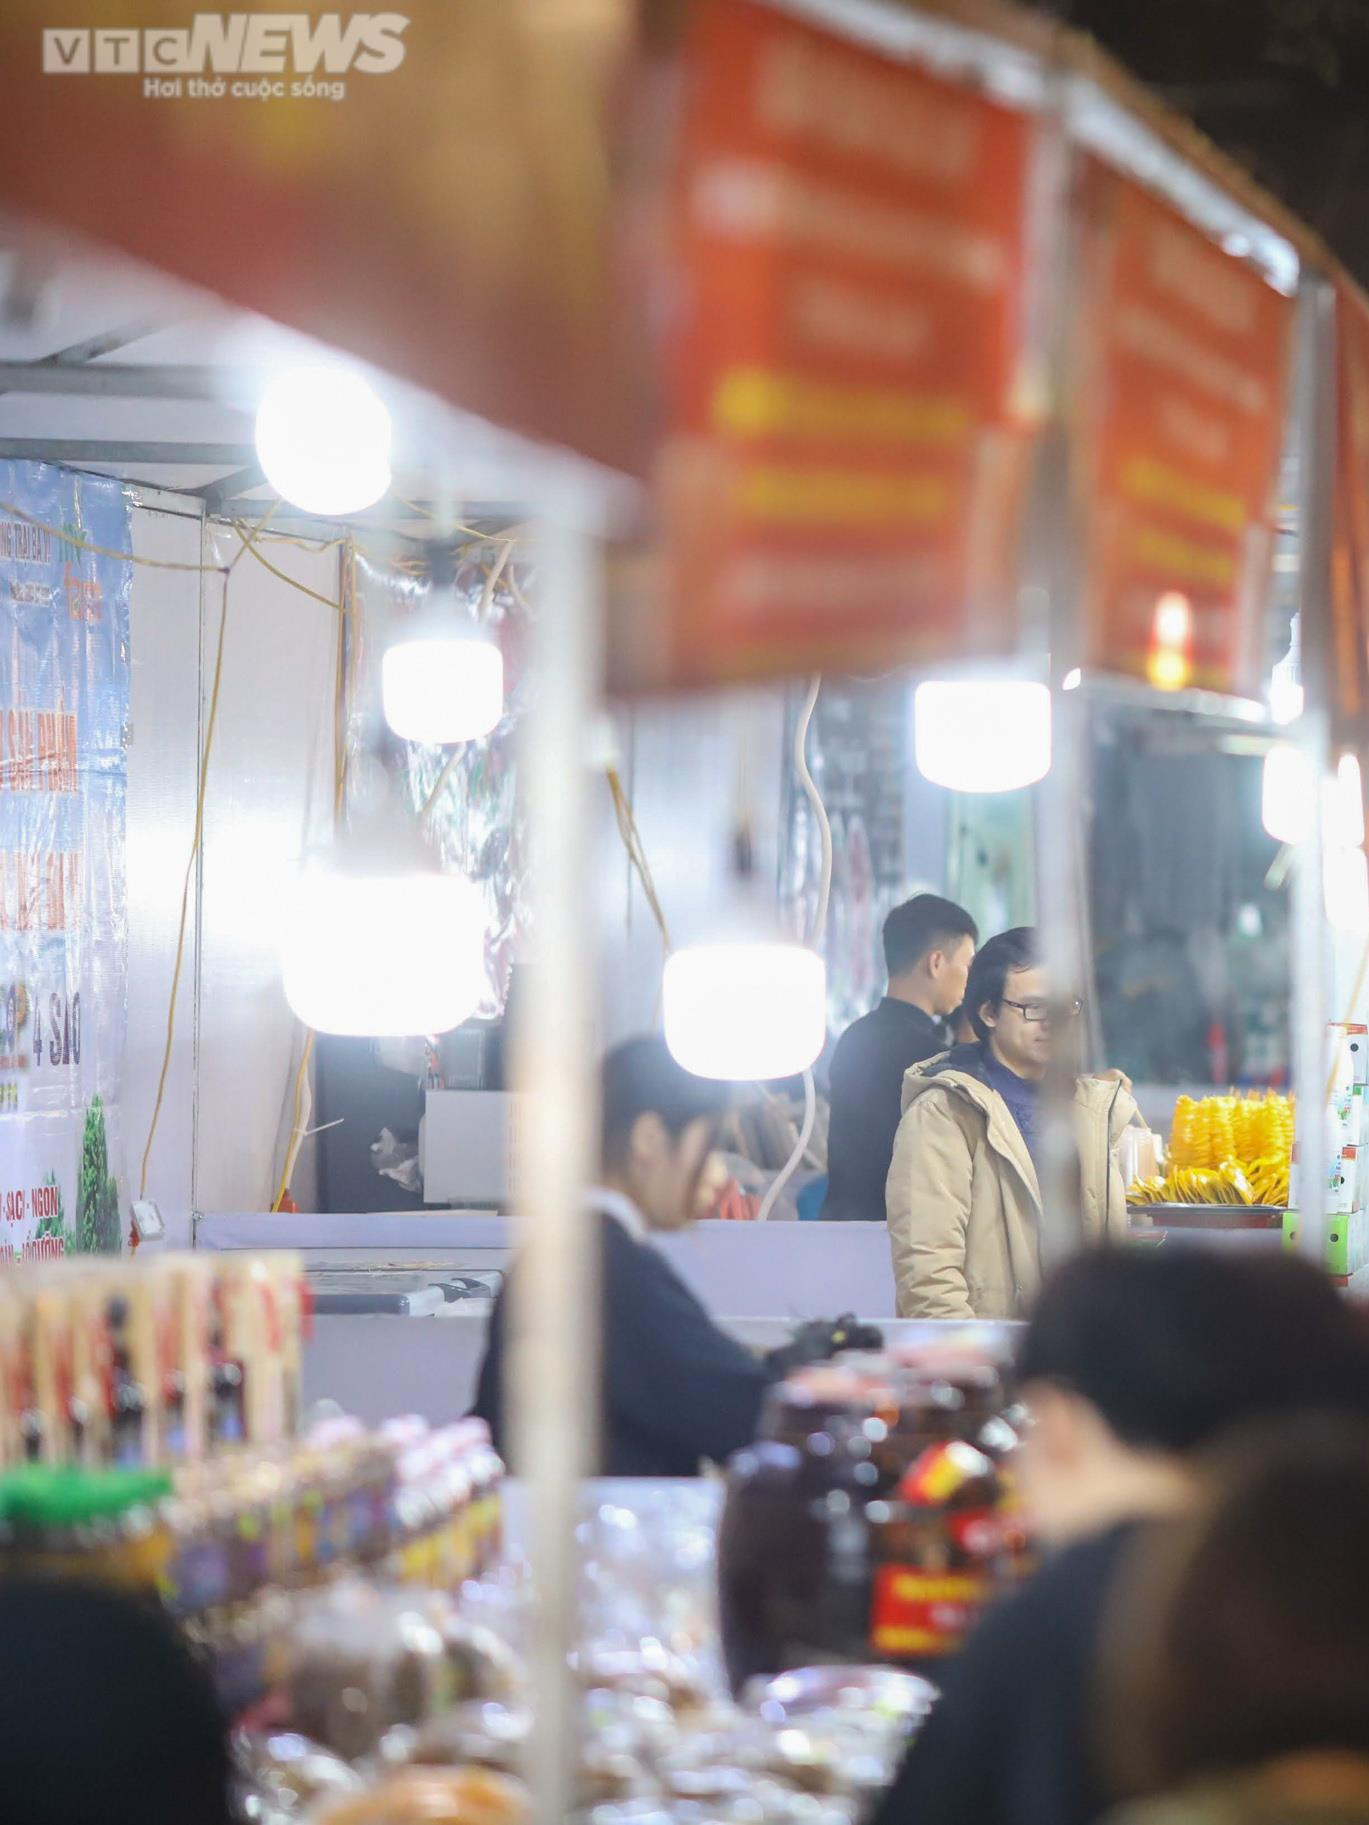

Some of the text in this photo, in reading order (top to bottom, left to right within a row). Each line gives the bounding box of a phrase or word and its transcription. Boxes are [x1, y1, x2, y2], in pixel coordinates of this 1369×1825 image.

[33, 994, 42, 1066] 4
[49, 991, 80, 1066] SAO
[32, 1186, 58, 1217] NGON
